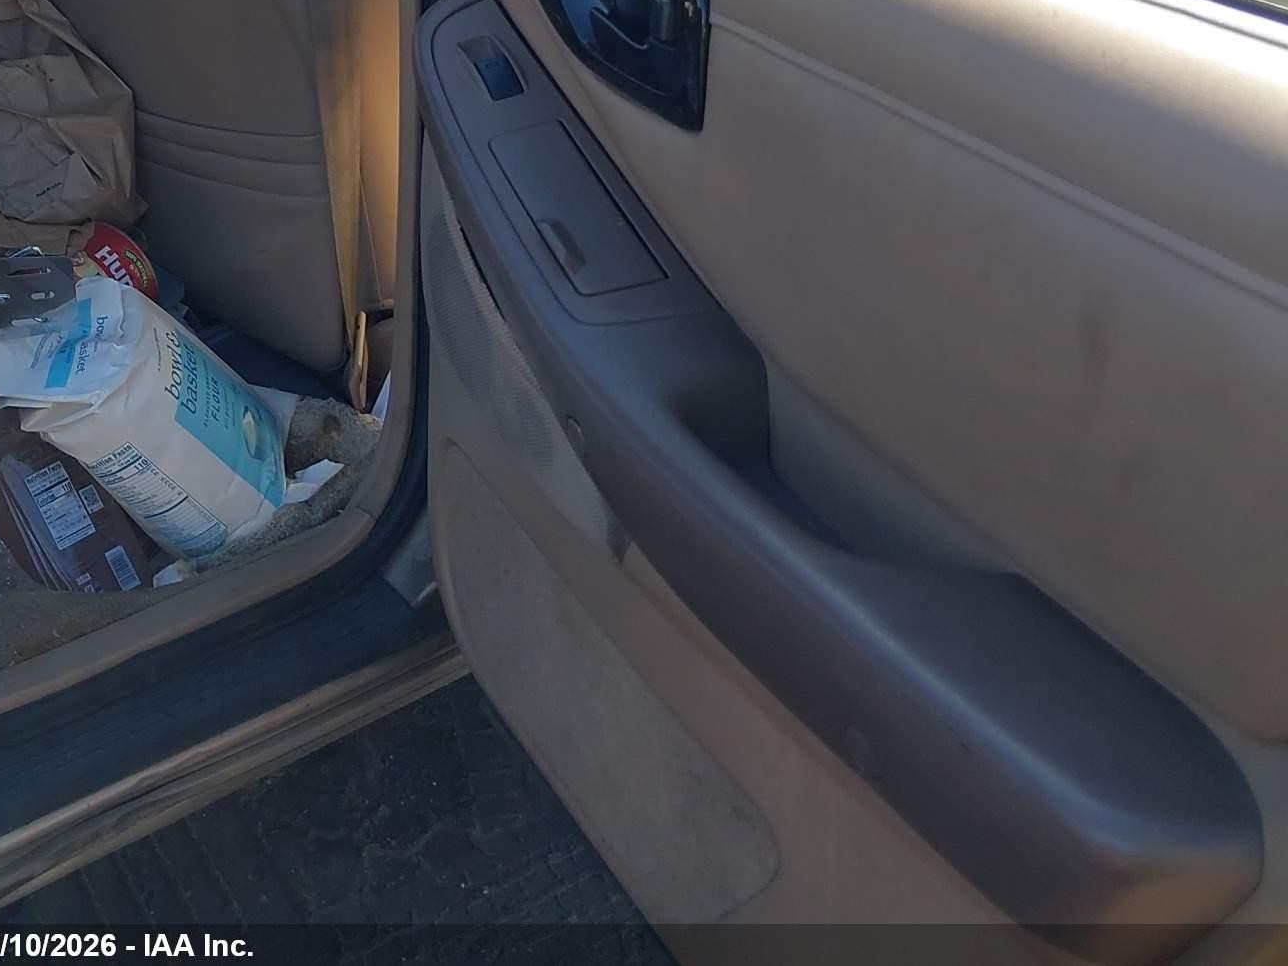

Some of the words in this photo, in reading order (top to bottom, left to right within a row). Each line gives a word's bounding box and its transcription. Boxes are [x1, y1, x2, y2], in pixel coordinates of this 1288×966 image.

[94, 245, 134, 286] Hun
[76, 340, 90, 375] asket
[165, 330, 181, 348] &
[164, 344, 183, 400] bowl
[181, 343, 198, 414] basket
[211, 376, 221, 421] FLOUR
[133, 459, 149, 471] 110
